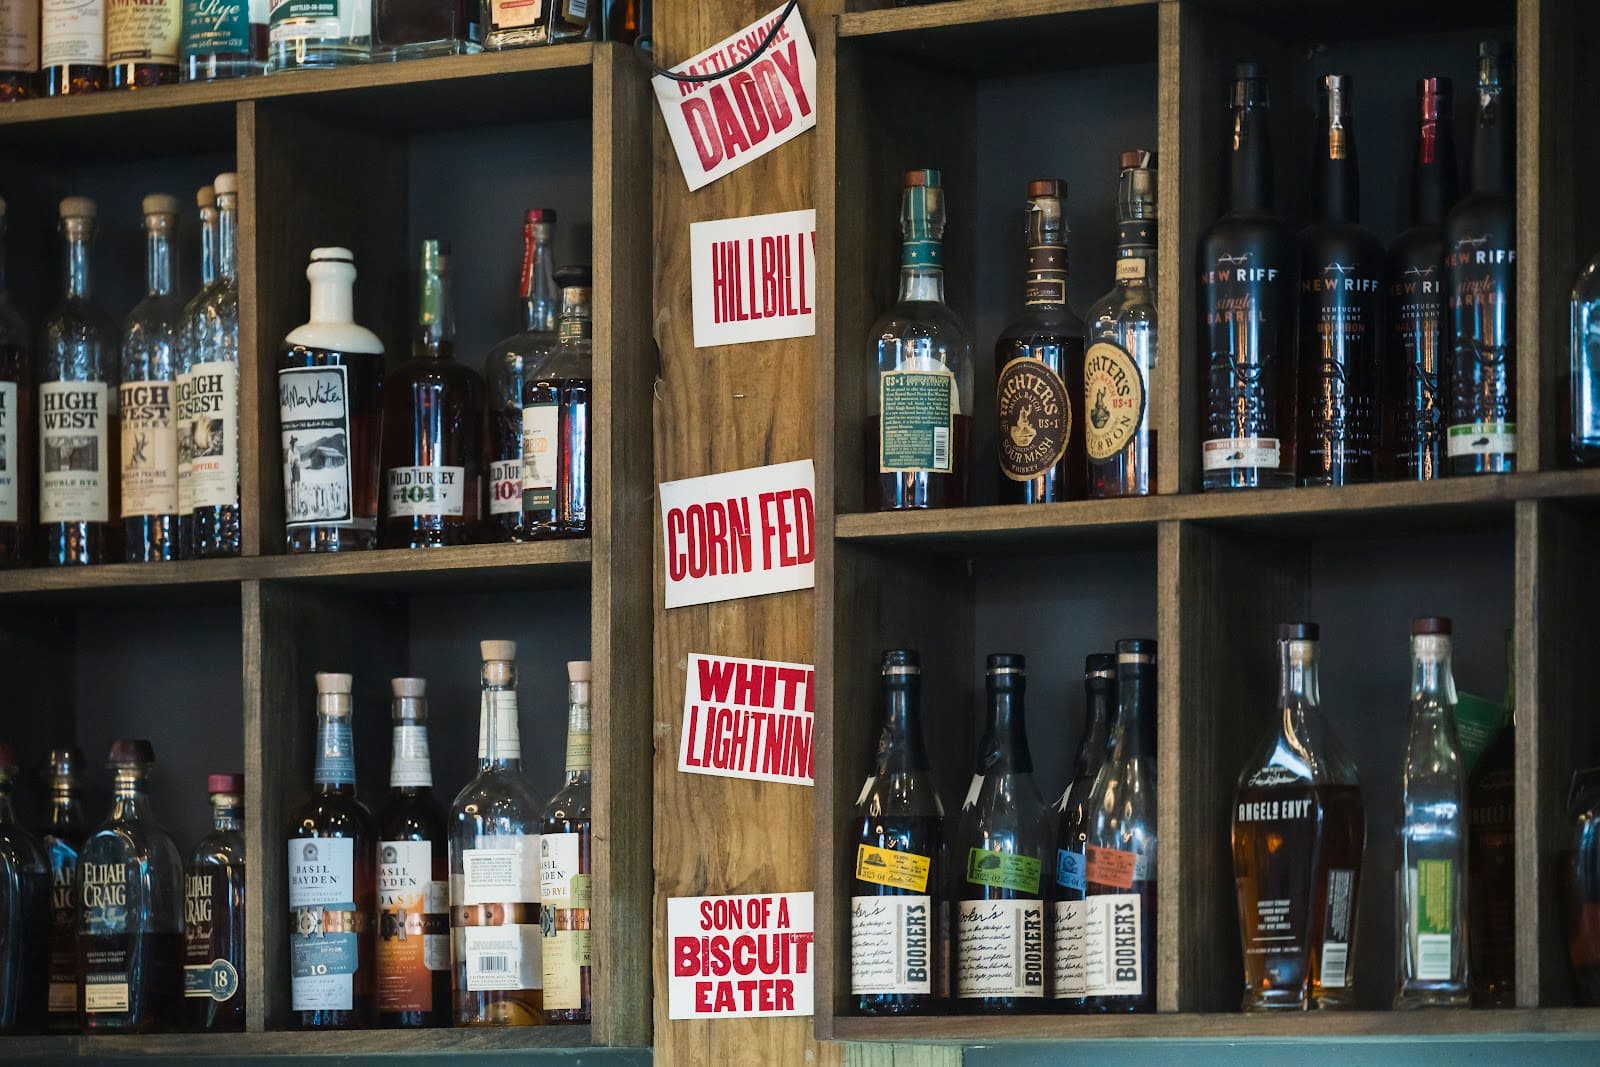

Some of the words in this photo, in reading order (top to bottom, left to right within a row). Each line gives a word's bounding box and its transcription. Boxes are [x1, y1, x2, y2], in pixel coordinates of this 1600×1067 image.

[680, 40, 812, 172] DADDY
[1476, 249, 1516, 265] RIFF
[712, 231, 816, 324] HILLBILL
[1236, 268, 1278, 282] RIFF
[1344, 278, 1378, 292] RIFF
[1423, 281, 1440, 293] RI
[1207, 310, 1267, 325] BARRL
[1317, 321, 1365, 332] BOBON
[44, 391, 98, 411] HIGH
[192, 394, 224, 413] EST
[44, 411, 98, 430] WEST
[1002, 440, 1022, 463] SOUR
[1024, 437, 1054, 463] MASH
[390, 471, 411, 486] WILD
[411, 468, 454, 485] TUREY
[400, 485, 436, 503] 101
[667, 497, 752, 581] CORN
[758, 488, 815, 570] FED
[686, 706, 815, 779] LIGHTNIN
[1282, 800, 1312, 819] ENVY
[84, 862, 126, 885] ELIJAH
[296, 865, 330, 873] BASIL
[382, 867, 409, 876] ASIL
[184, 873, 213, 896] ELIJAH
[292, 875, 337, 885] HAYDEN
[382, 878, 416, 886] YDEN
[83, 884, 126, 910] CRAIG
[552, 887, 567, 896] RYE
[184, 898, 213, 924] CRAIG
[700, 899, 743, 931] SON
[747, 897, 773, 929] OF
[777, 897, 790, 928] A
[907, 905, 928, 982] BOOKER'S
[1024, 910, 1042, 986] BOOKER'S
[1115, 903, 1136, 982] BOOKER'S
[674, 932, 815, 977] BISCUIT
[214, 969, 228, 987] 18
[310, 964, 327, 975] 10
[695, 979, 794, 1012] EATER
